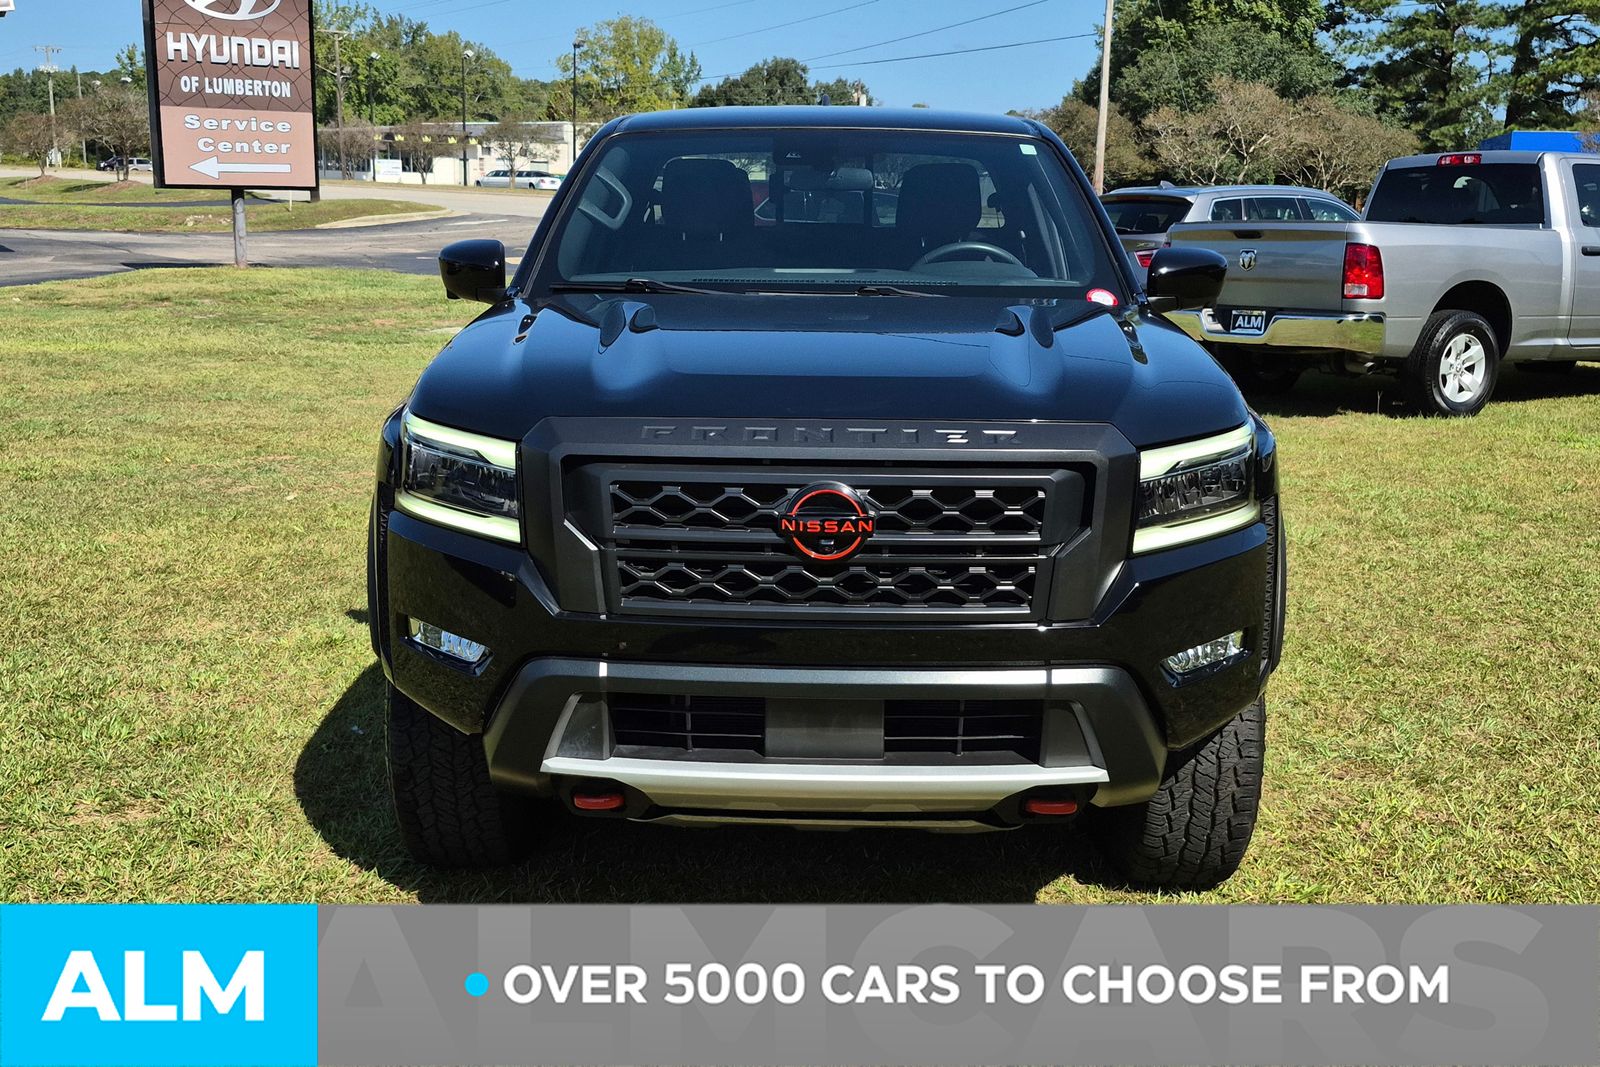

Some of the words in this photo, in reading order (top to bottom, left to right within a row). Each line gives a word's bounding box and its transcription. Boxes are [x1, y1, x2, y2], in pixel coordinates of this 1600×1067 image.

[166, 31, 300, 69] HYUNDAI
[180, 75, 199, 92] OF
[204, 77, 291, 97] LUMBERTON
[184, 114, 292, 132] Service
[197, 137, 291, 154] Center
[1235, 315, 1262, 328] ALM
[640, 425, 1023, 445] FRONTIER
[781, 519, 874, 533] NISSAN
